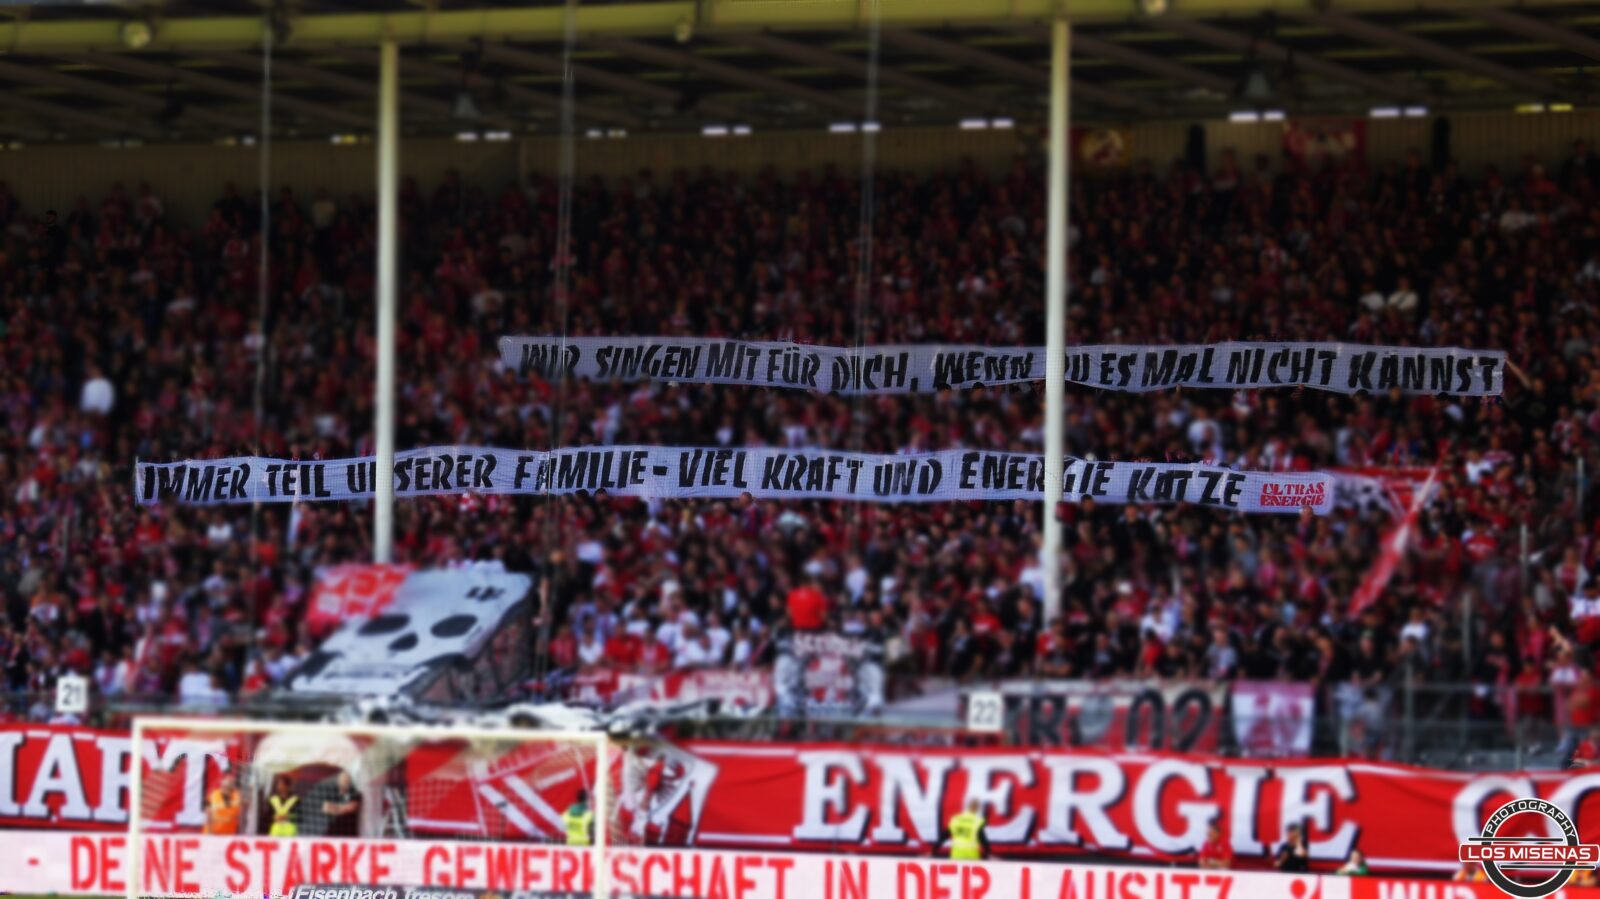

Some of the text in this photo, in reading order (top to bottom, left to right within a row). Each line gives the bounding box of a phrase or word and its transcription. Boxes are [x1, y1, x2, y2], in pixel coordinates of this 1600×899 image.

[520, 344, 581, 380] WIR
[596, 345, 700, 377] SINGEN
[705, 342, 760, 380] MIT
[767, 347, 820, 387] FÜR
[933, 352, 1033, 387] WENN
[1064, 352, 1090, 382] U
[1100, 352, 1137, 386] ES
[1141, 348, 1214, 386] MAL
[1226, 347, 1337, 385] NICHT
[143, 463, 250, 501] IMMER
[265, 464, 330, 497] TEIL
[347, 454, 498, 494] USERER
[679, 449, 747, 487] VIEL
[761, 454, 863, 494] KRAFT
[873, 458, 942, 496] UND
[1126, 470, 1246, 506] KATZE
[1262, 482, 1324, 495] ULTRAS
[1260, 494, 1324, 506] ENERGIE
[62, 684, 82, 706] 21
[973, 700, 998, 724] 22
[794, 752, 1358, 864] ENERGIE
[71, 836, 200, 894] DENE
[825, 860, 868, 899] IN
